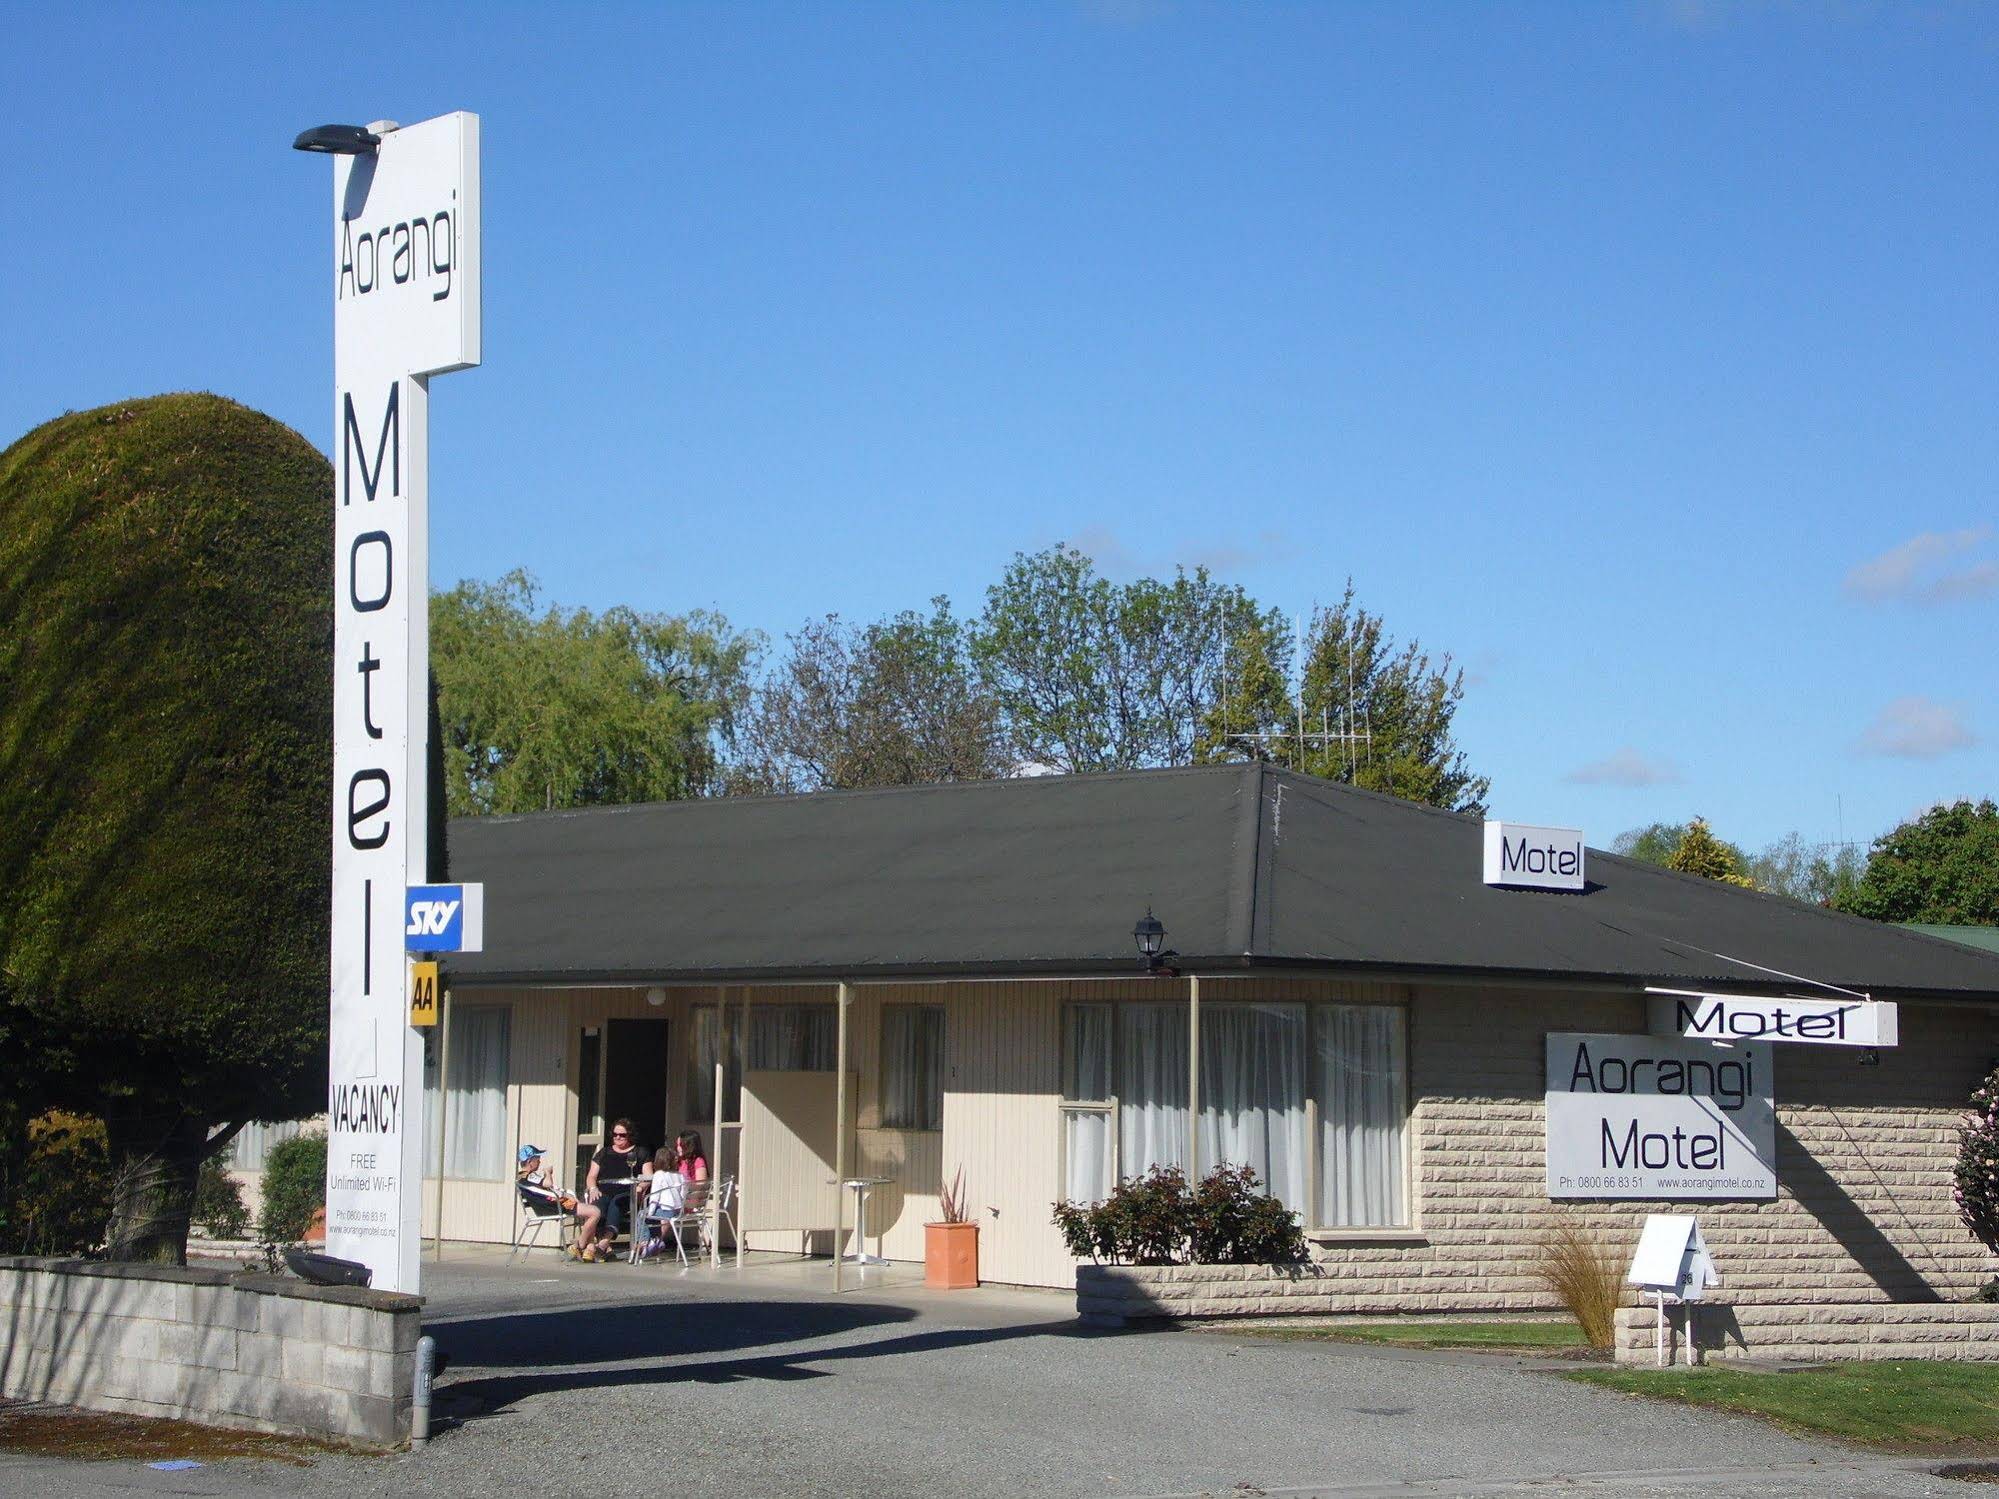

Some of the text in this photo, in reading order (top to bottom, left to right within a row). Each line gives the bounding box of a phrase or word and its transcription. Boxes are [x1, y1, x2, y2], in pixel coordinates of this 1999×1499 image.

[339, 189, 457, 302] Aorangi
[343, 380, 400, 996] Motel
[1502, 836, 1580, 876] Motel
[406, 900, 460, 935] SKY
[411, 976, 433, 1011] AA
[1676, 1000, 1845, 1040] Motel
[1569, 1041, 1752, 1111] Aorangi
[332, 1083, 400, 1134] VACANCY
[350, 1153, 377, 1169] FREE
[1600, 1117, 1725, 1170] Motel
[330, 1175, 397, 1193] Unlimited Wi-Fi
[1559, 1176, 1643, 1189] Ph: 0800 66 83 51
[1657, 1177, 1765, 1191] www.aorangimotel.co.nz
[1681, 1273, 1693, 1285] 26
